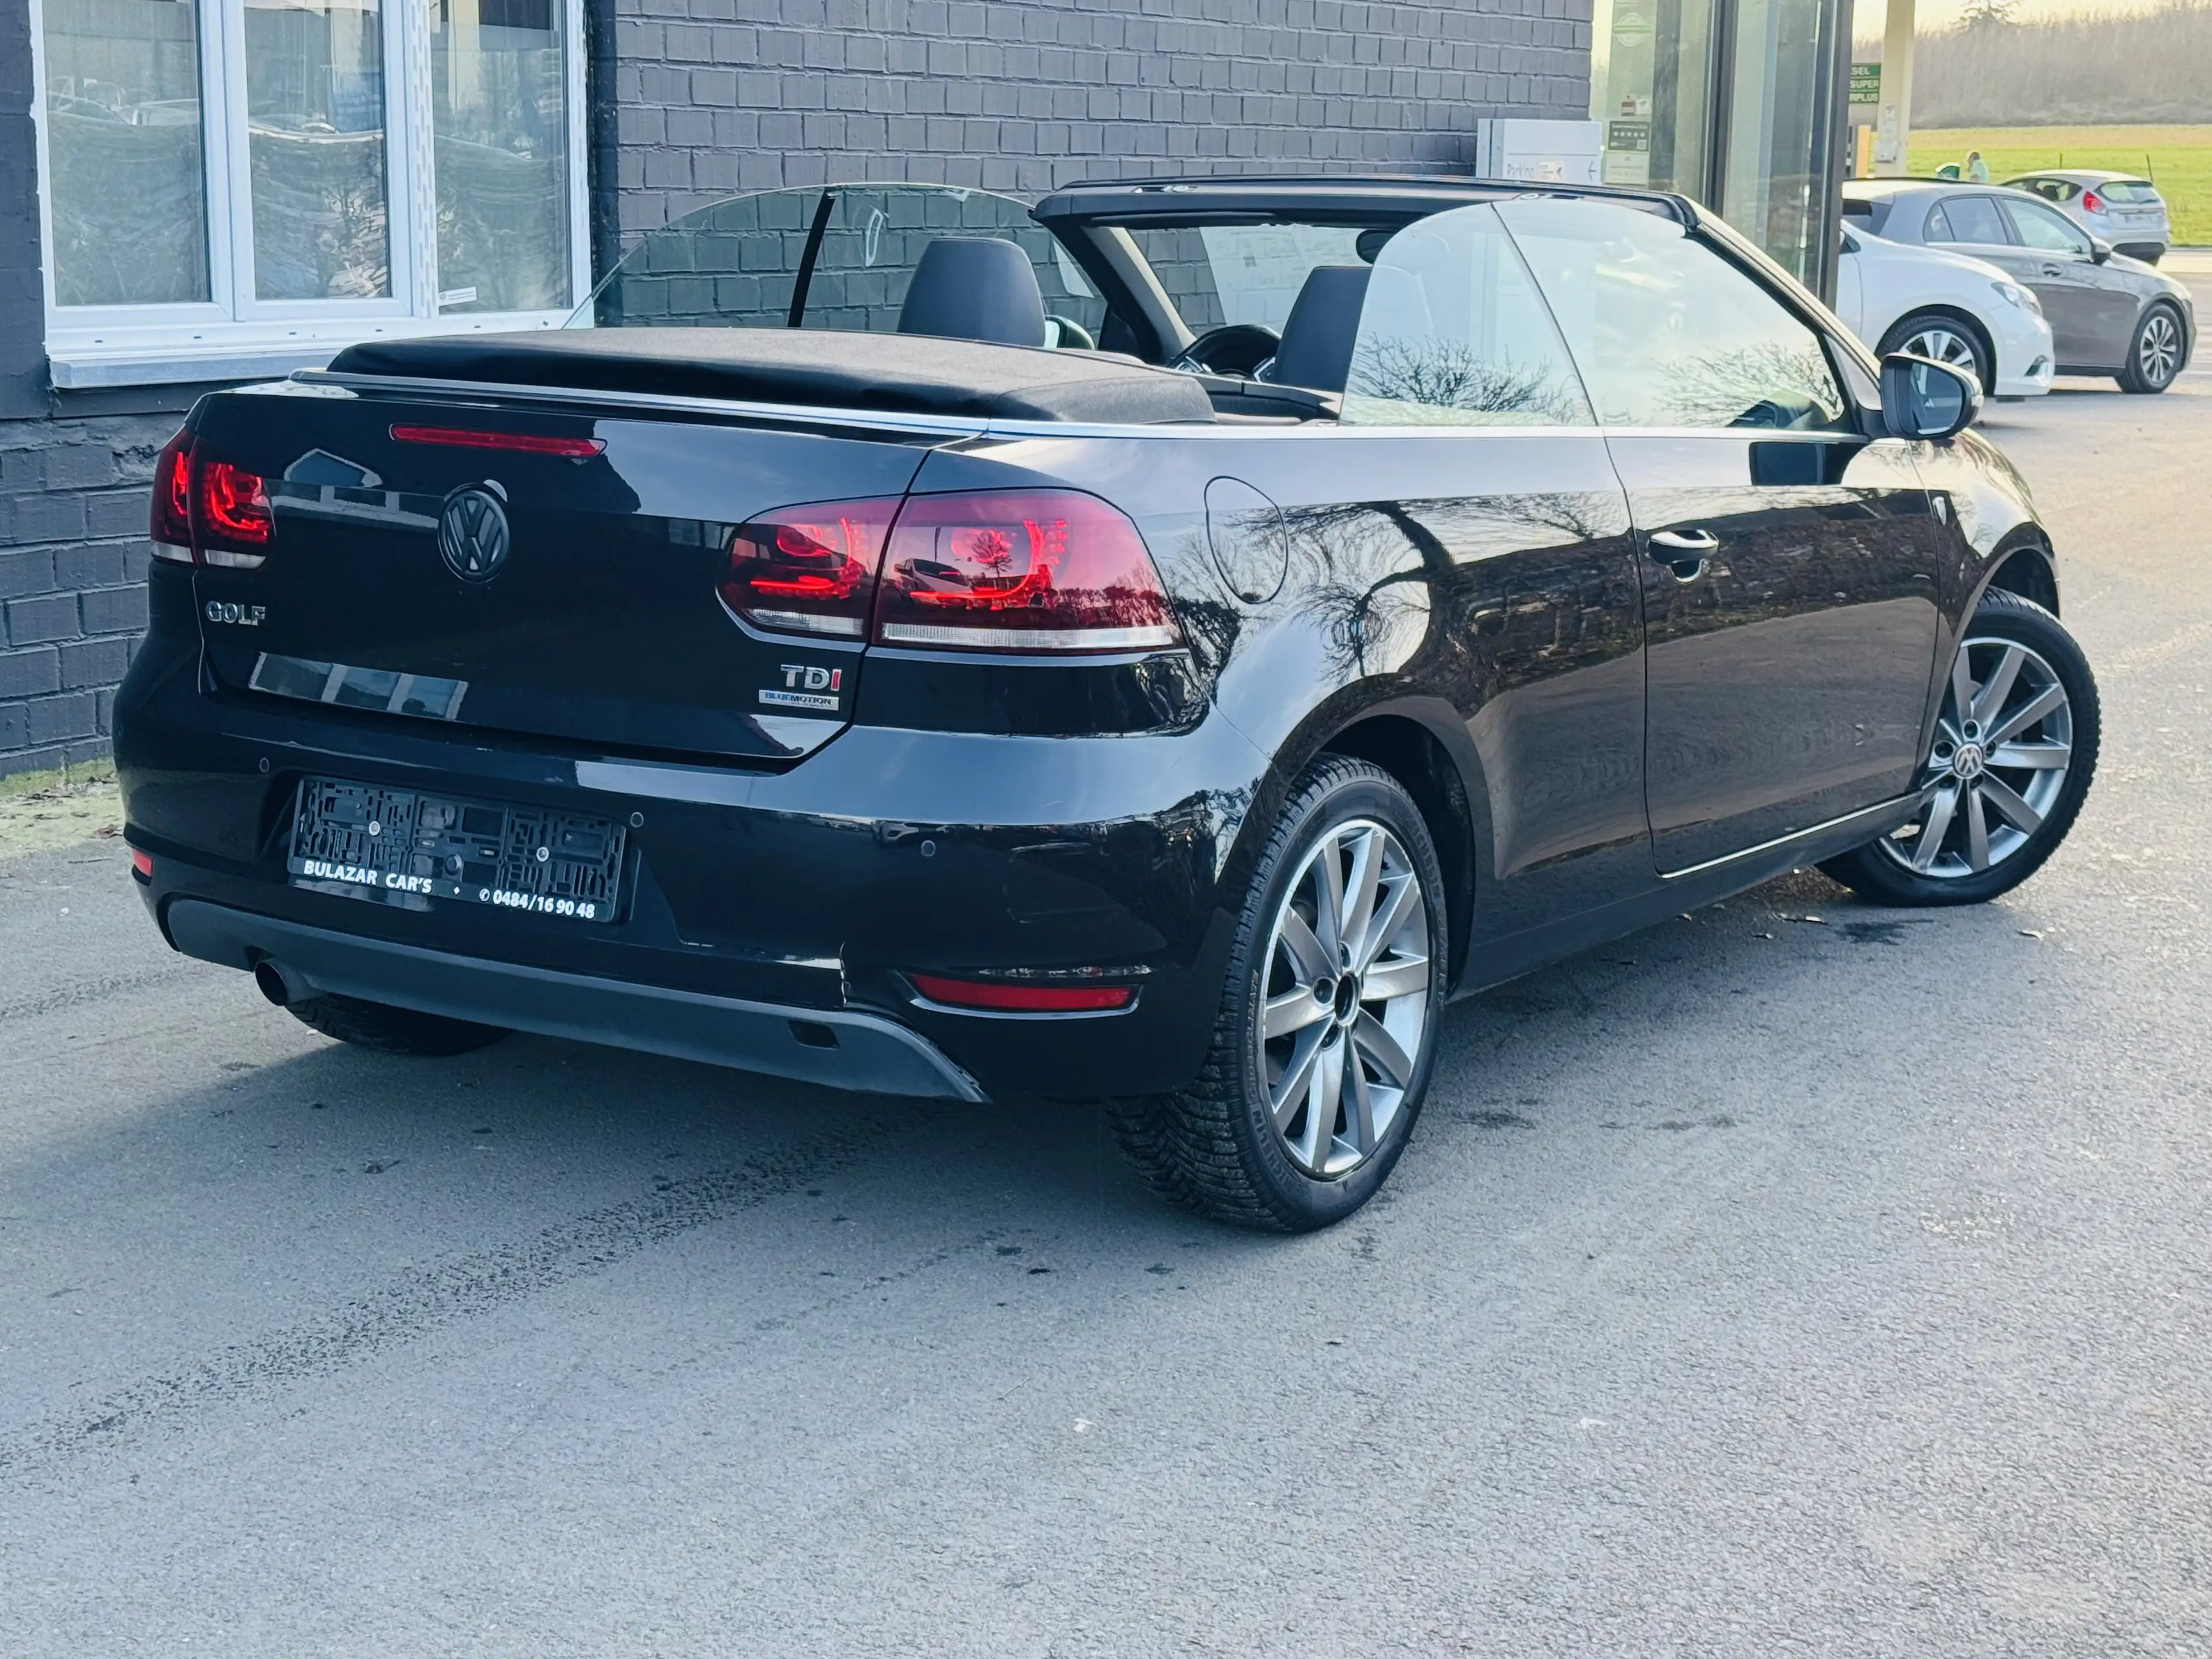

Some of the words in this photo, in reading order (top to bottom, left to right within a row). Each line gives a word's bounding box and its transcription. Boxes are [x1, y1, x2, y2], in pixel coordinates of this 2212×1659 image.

[206, 601, 266, 626] GOLF
[781, 664, 842, 691] TDI
[304, 860, 378, 885] BULAZAR
[385, 873, 433, 893] CAR'S
[556, 899, 575, 916] 90
[576, 903, 596, 919] 48
